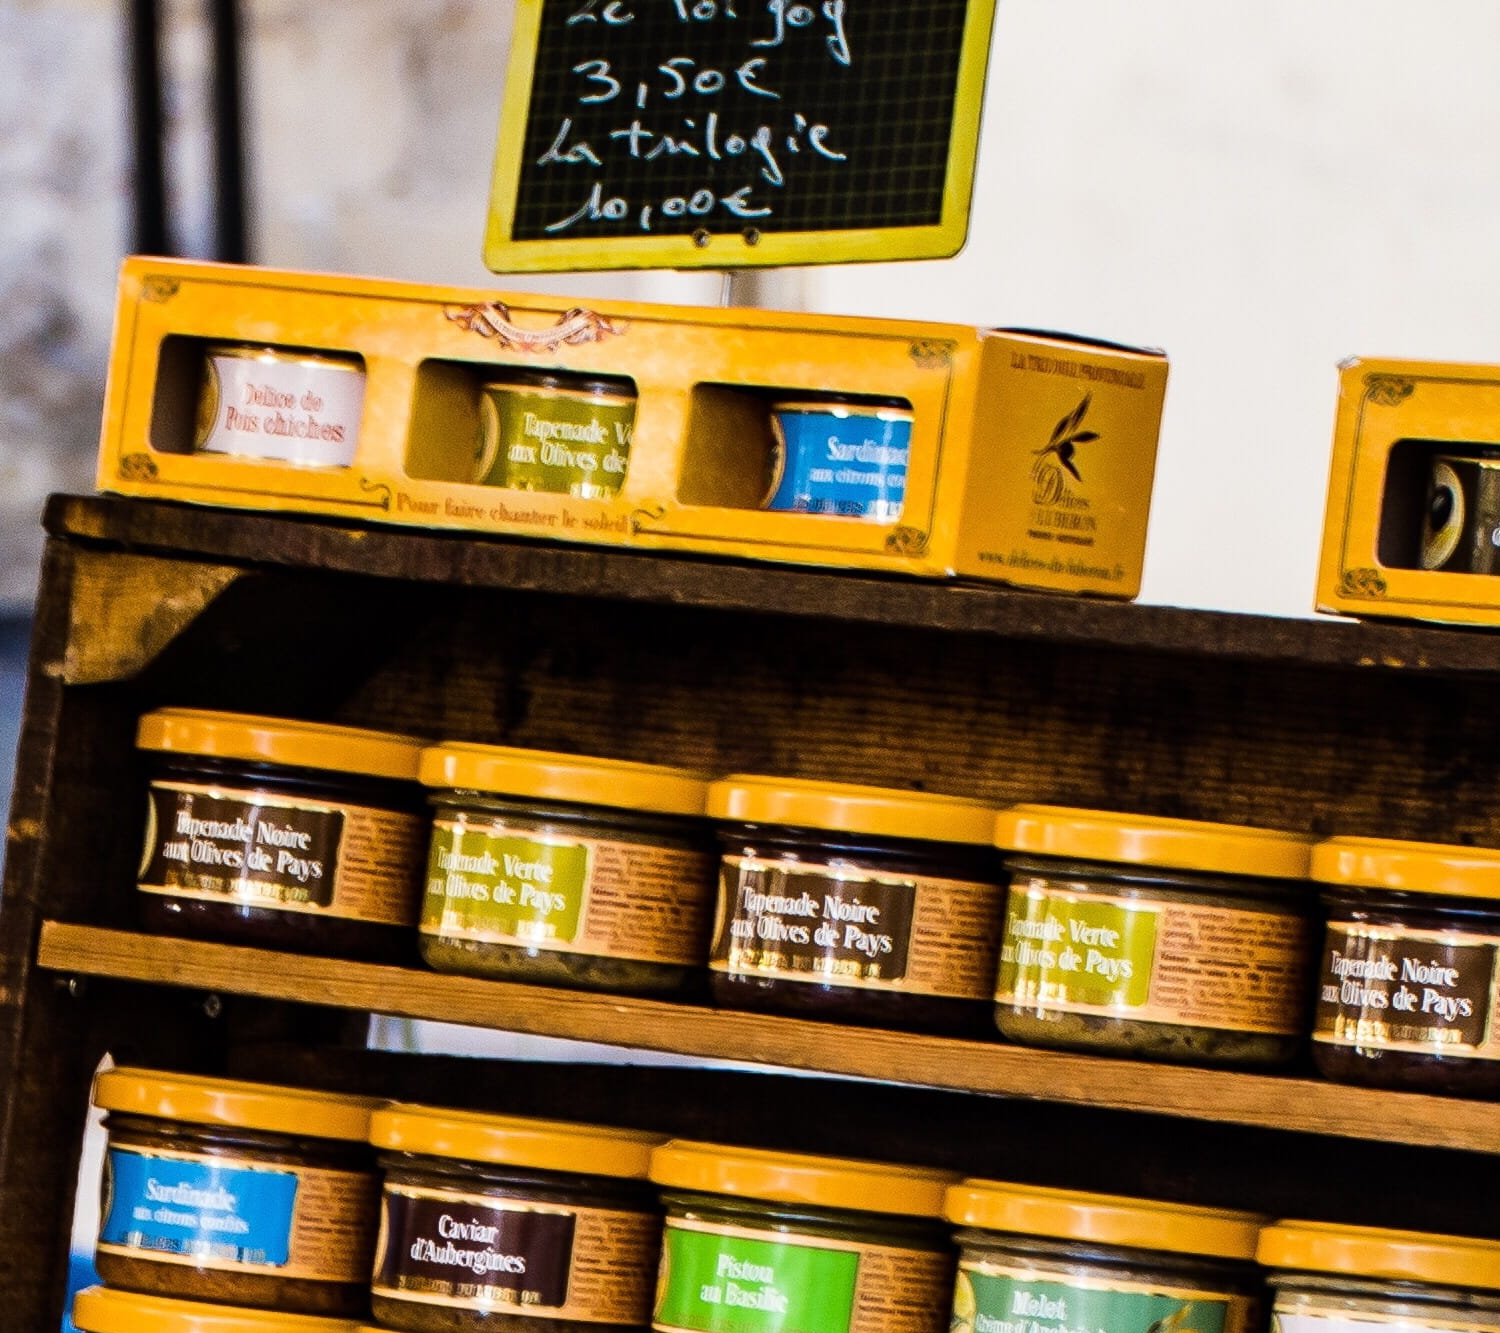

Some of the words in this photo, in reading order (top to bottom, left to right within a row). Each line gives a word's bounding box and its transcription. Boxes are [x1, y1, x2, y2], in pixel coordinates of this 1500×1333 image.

[573, 59, 780, 108] 3,50€
[537, 117, 602, 166] La
[611, 112, 846, 186] trilogie
[545, 183, 772, 232] 10,00€
[176, 812, 251, 842] Tapenade
[256, 823, 311, 850] Noire
[190, 842, 241, 868] Olives
[248, 852, 274, 872] de
[277, 855, 323, 882] Pays
[743, 887, 820, 919] Tapenade
[823, 896, 880, 925] Noire
[757, 917, 809, 945] Olives
[814, 927, 840, 948] de
[844, 927, 893, 958] Pays
